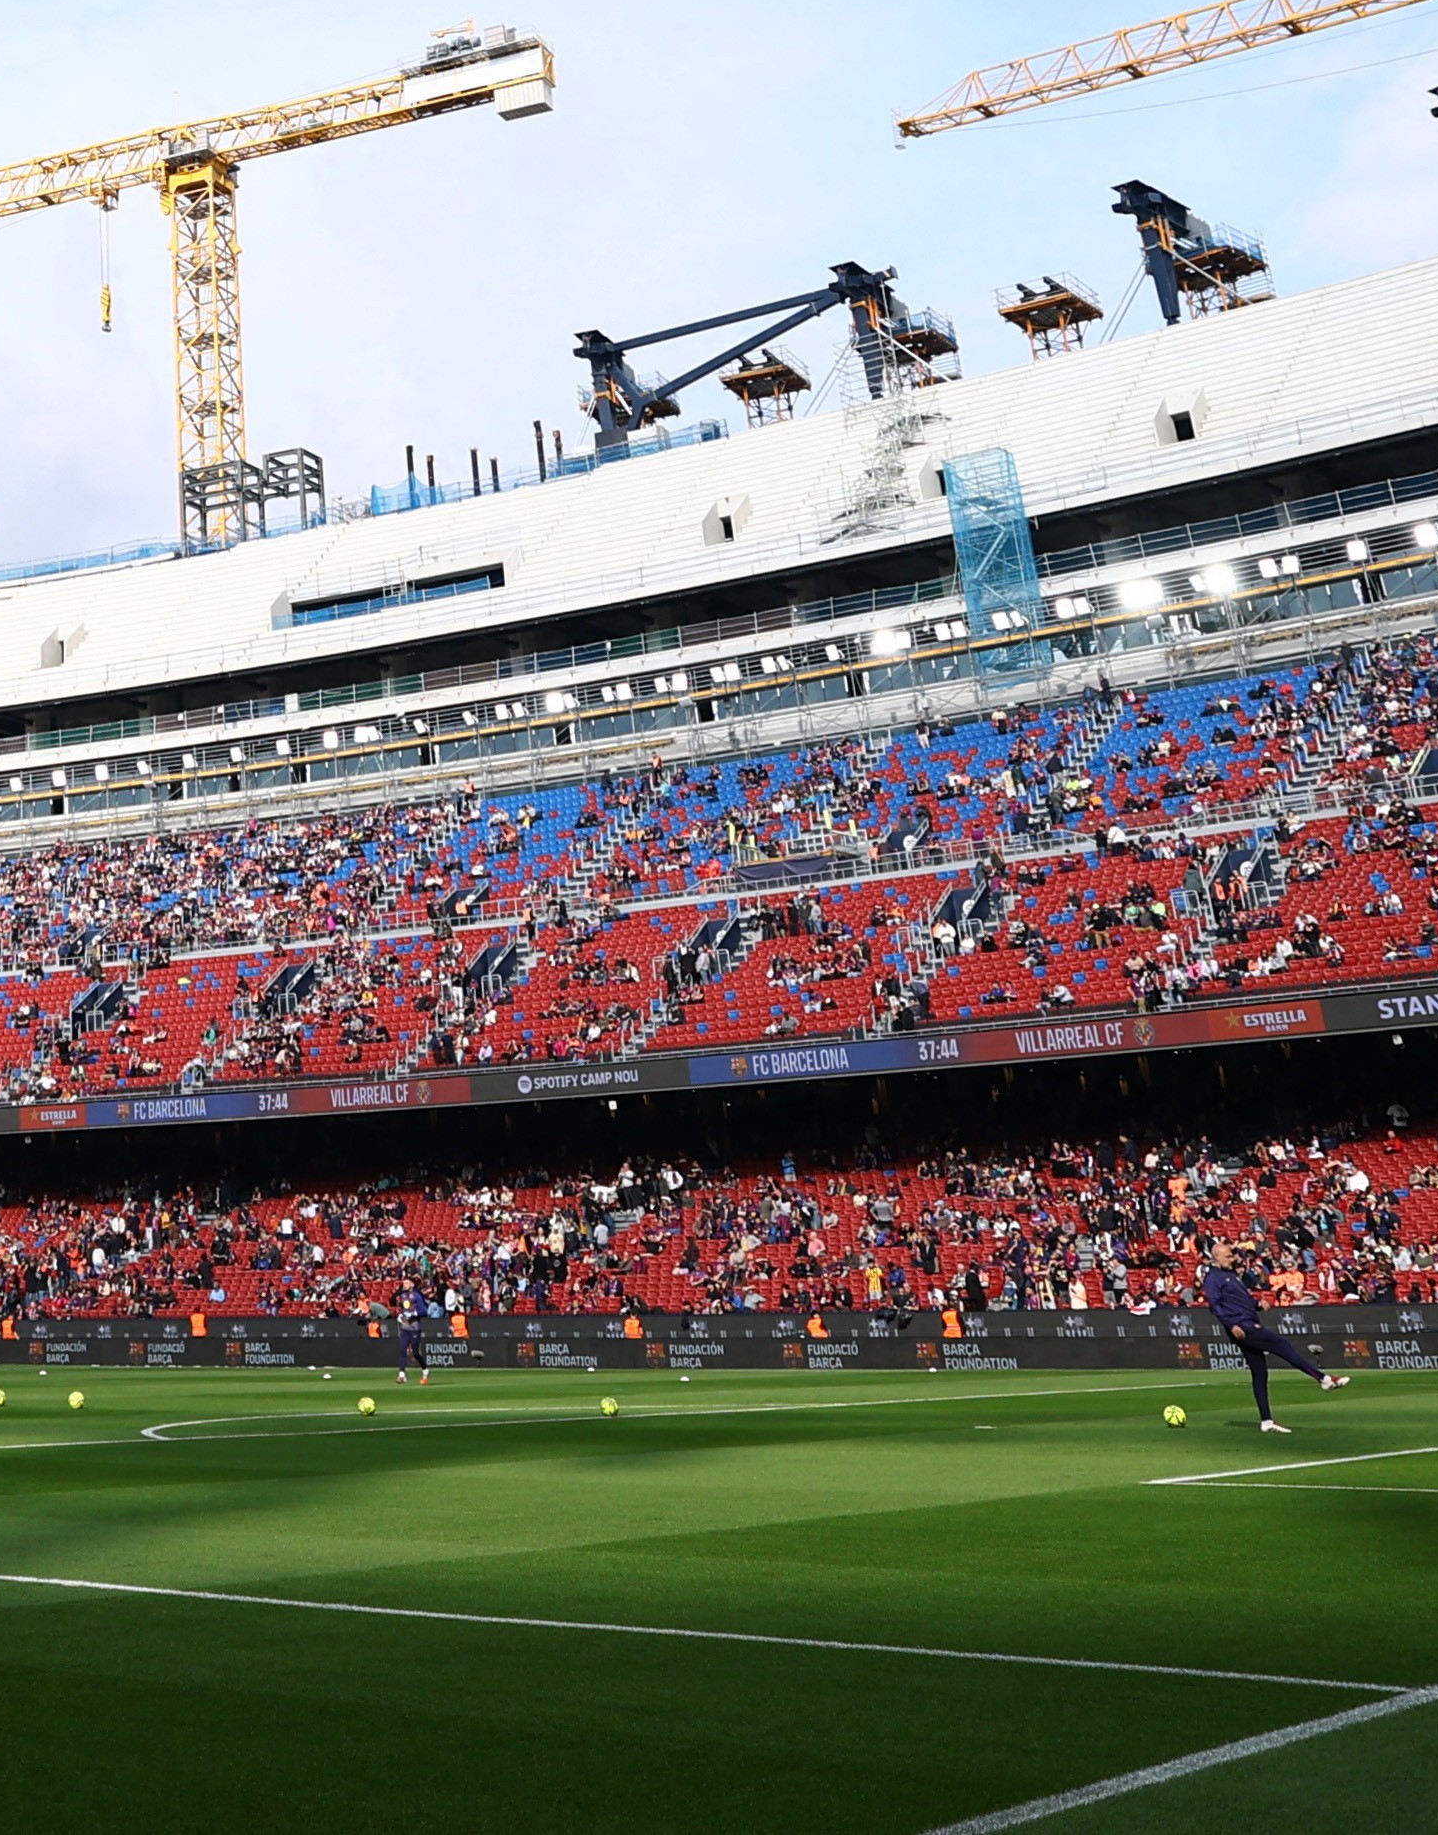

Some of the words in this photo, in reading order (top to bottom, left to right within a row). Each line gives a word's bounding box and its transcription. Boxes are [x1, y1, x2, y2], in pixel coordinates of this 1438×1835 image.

[1243, 1009, 1307, 1028] ESTRELLA
[1014, 1025, 1103, 1054] VILLARREAL
[1103, 1022, 1123, 1046] CF
[918, 1038, 959, 1061] 37:44
[752, 1054, 769, 1076] FC
[771, 1048, 849, 1074] BARCELONA
[533, 1074, 578, 1090] SPOTIFY
[580, 1072, 613, 1087] CAMP
[614, 1069, 639, 1083] NOU
[258, 1093, 289, 1111] 37:44
[329, 1086, 394, 1107] VILLARREAL
[393, 1083, 410, 1103] CF
[40, 1109, 77, 1122] ESTRELLA
[134, 1104, 147, 1121] FC
[148, 1098, 206, 1120] BARCELONA
[46, 1342, 87, 1353] FUNDACIÓN
[147, 1342, 186, 1354] FUNDACIÓ
[244, 1342, 271, 1354] BARÇA
[425, 1341, 468, 1355] FUNDACIÓ
[539, 1342, 570, 1356] BARÇA
[668, 1341, 725, 1356] FUNDACIÓN
[807, 1340, 859, 1355] FUNDACIÓ
[942, 1343, 981, 1358] BARÇA
[1375, 1340, 1421, 1356] BARÇA
[46, 1353, 70, 1364] BARÇA
[147, 1353, 173, 1365] BARÇA
[244, 1353, 295, 1365] FOUNDATION
[426, 1355, 454, 1368] BARÇA
[539, 1355, 598, 1368] FOUNDATION
[670, 1355, 703, 1370] BARÇA
[809, 1355, 844, 1370] BARÇA
[944, 1357, 1018, 1370] FOUNDATION
